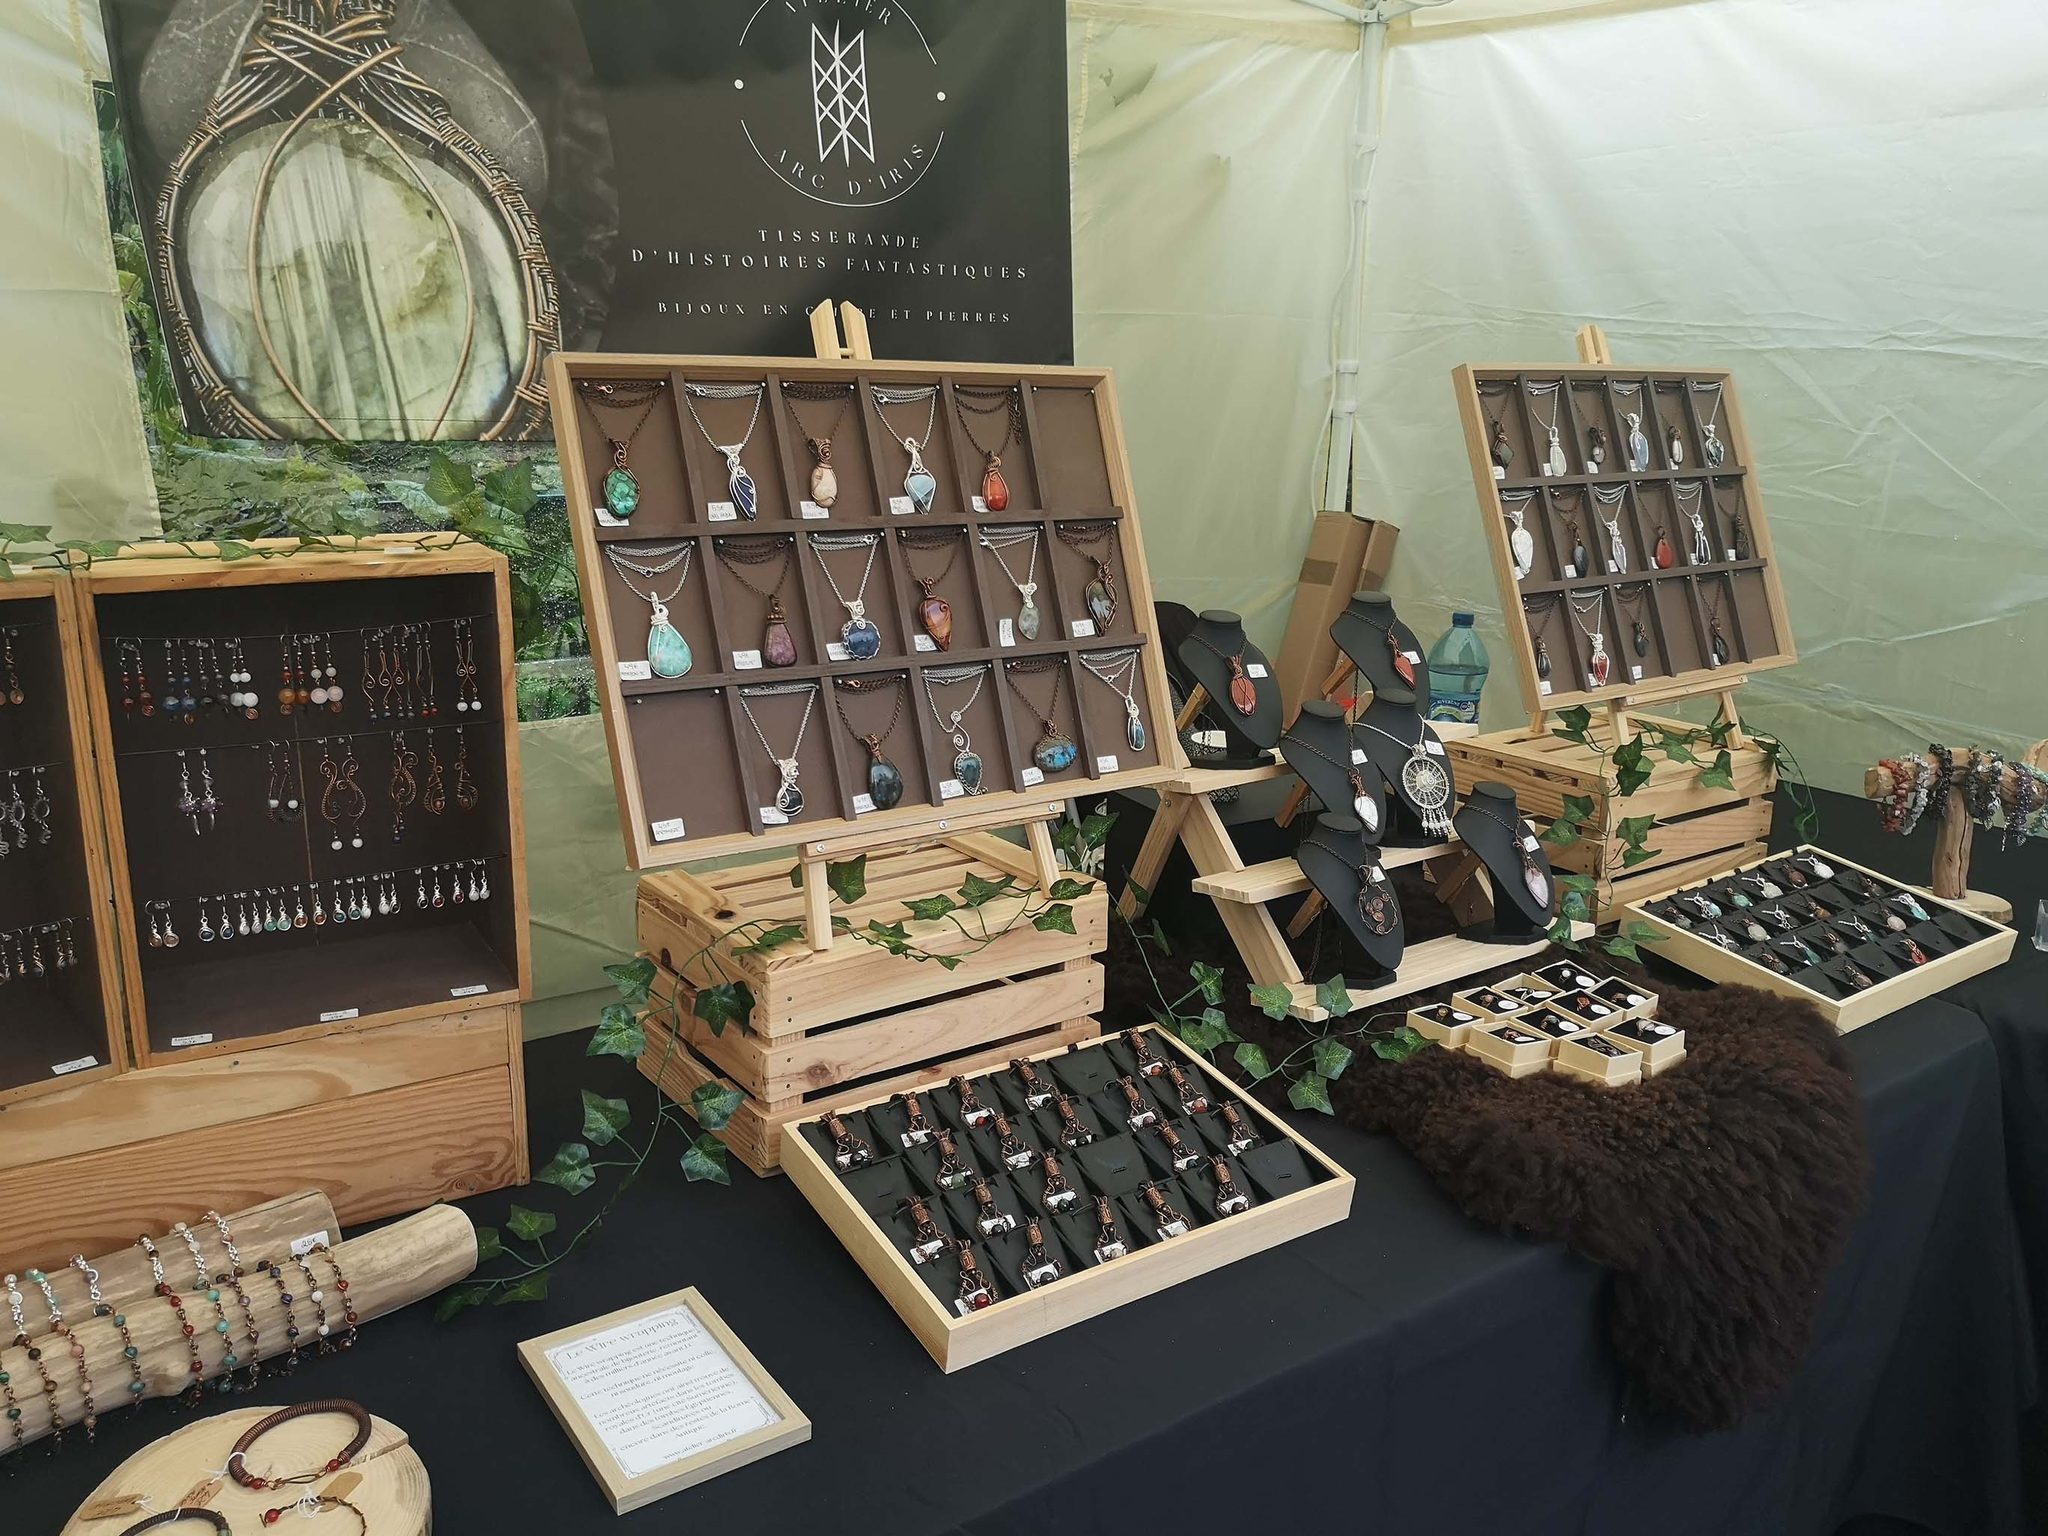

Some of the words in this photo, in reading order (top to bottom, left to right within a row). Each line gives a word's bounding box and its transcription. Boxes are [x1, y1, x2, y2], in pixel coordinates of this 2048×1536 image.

[776, 149, 825, 189] ARC
[848, 144, 923, 195] D'IRIS
[758, 229, 920, 249] TISSERANDE
[632, 249, 826, 269] D'HISTOIRES
[846, 257, 1026, 279] FANTASTIQUES
[658, 302, 745, 315] BIJOUX
[763, 303, 789, 315] EN
[891, 308, 911, 320] ET
[926, 310, 1009, 323] PIERRES
[585, 1339, 618, 1353] Wire
[619, 1318, 680, 1341] wrapping
